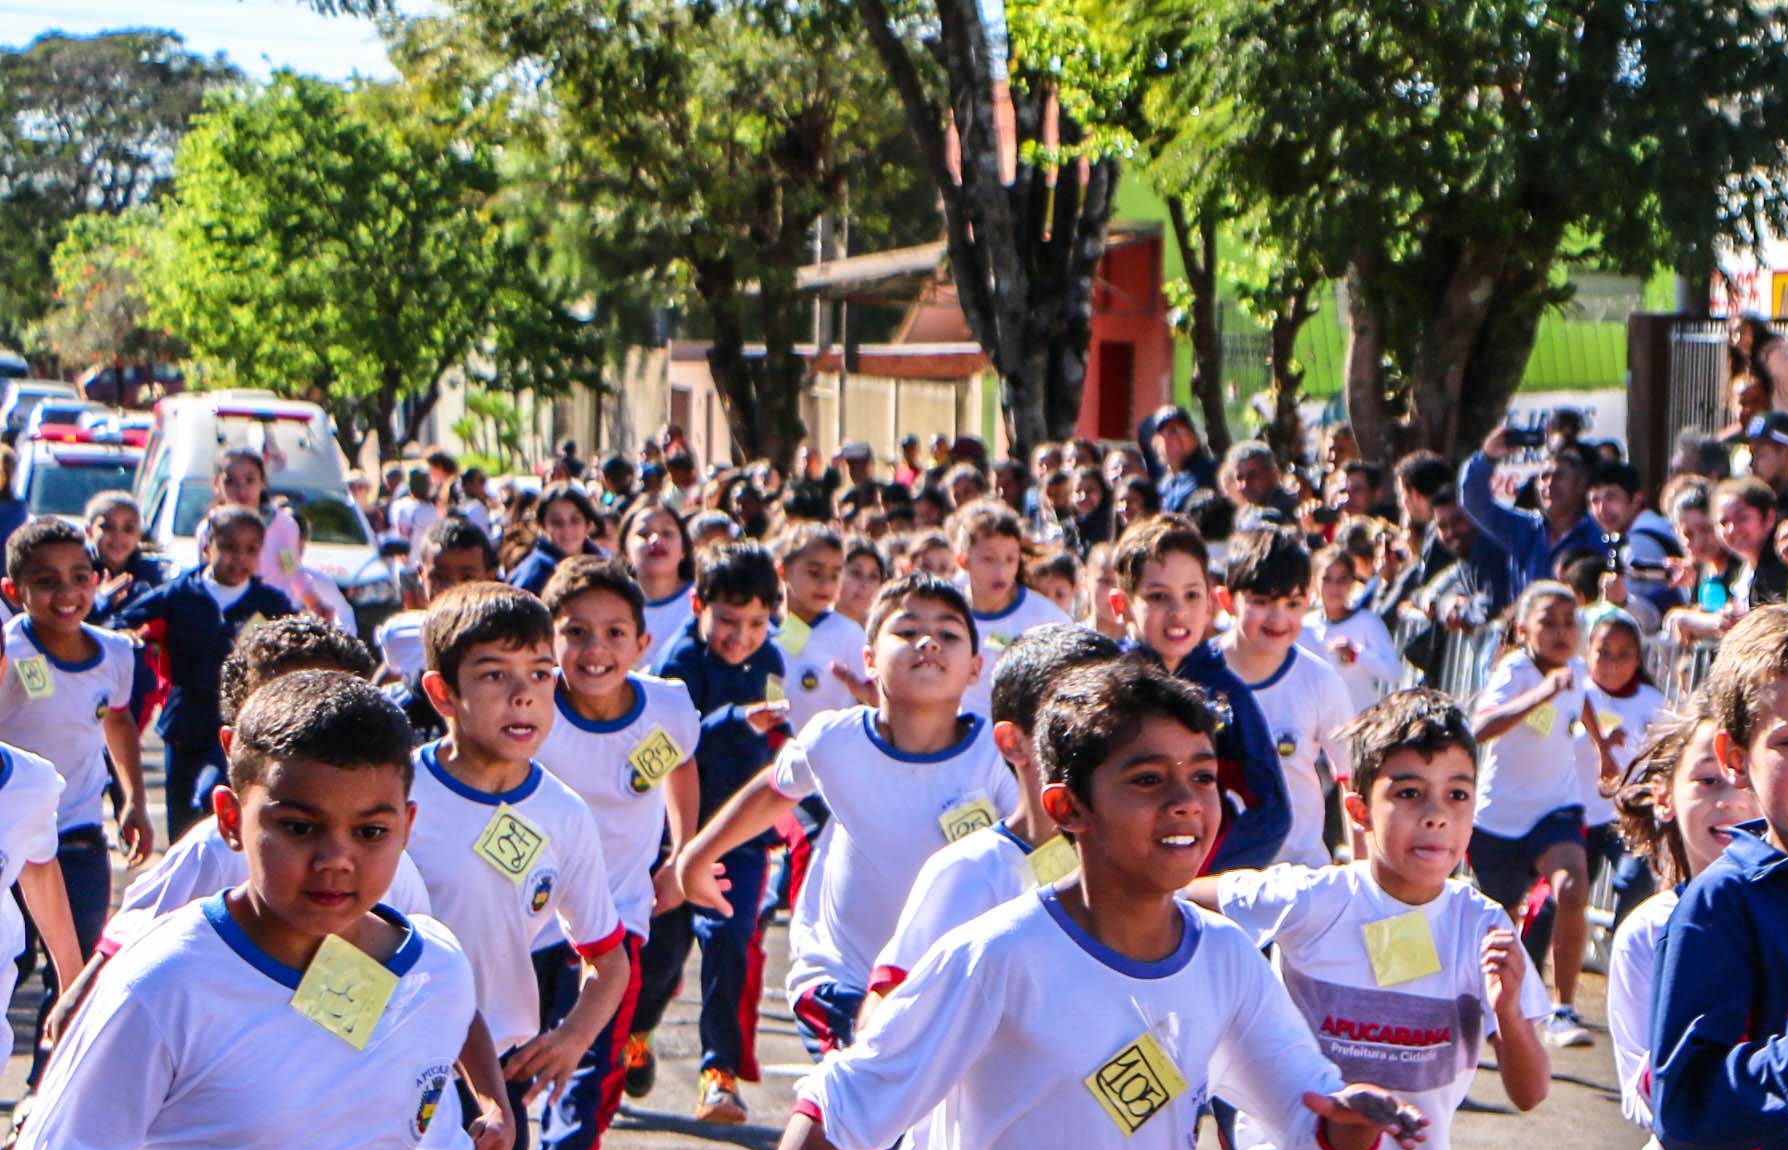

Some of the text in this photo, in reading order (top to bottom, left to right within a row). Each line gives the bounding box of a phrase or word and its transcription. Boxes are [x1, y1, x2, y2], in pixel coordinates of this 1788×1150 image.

[1320, 1014, 1453, 1048] APUCARANA
[1331, 1042, 1386, 1060] Prefeitura
[1105, 1058, 1163, 1118] 105
